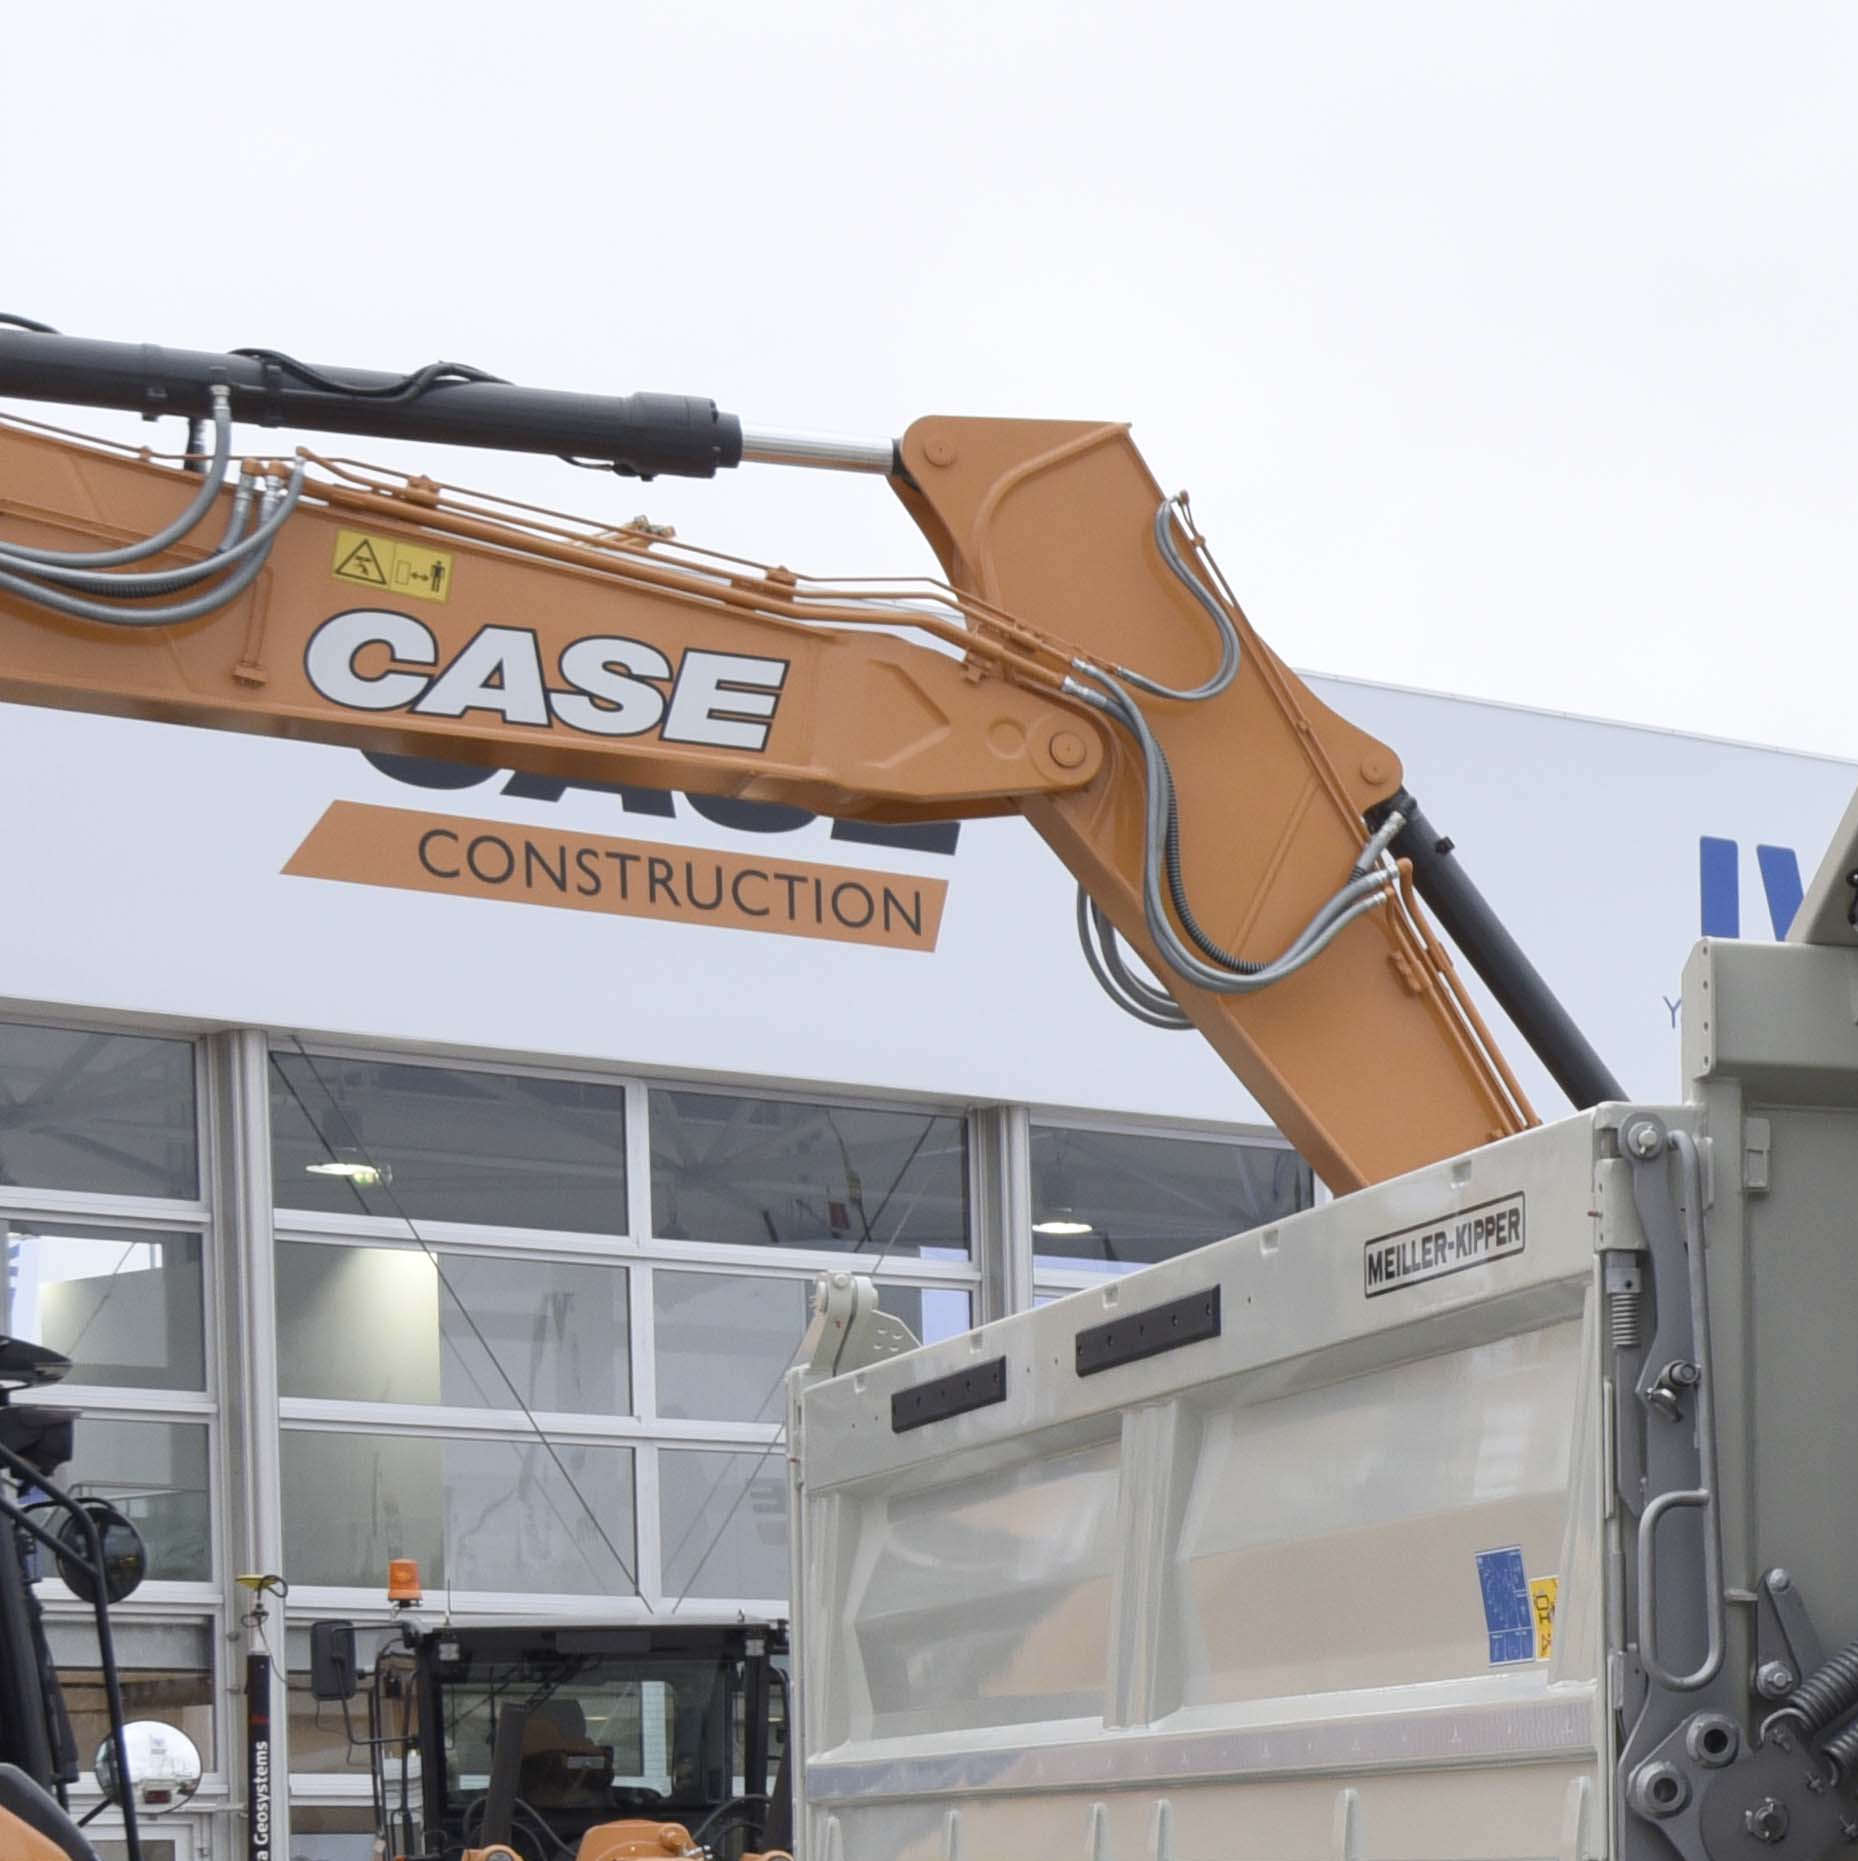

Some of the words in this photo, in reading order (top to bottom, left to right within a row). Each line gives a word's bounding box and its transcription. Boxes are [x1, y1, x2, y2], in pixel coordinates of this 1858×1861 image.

[304, 608, 789, 751] CASE
[418, 829, 923, 936] CONSTRUCTION
[1368, 1207, 1521, 1286] MEILLER-KIPPER
[253, 1741, 269, 1846] Geosystems
